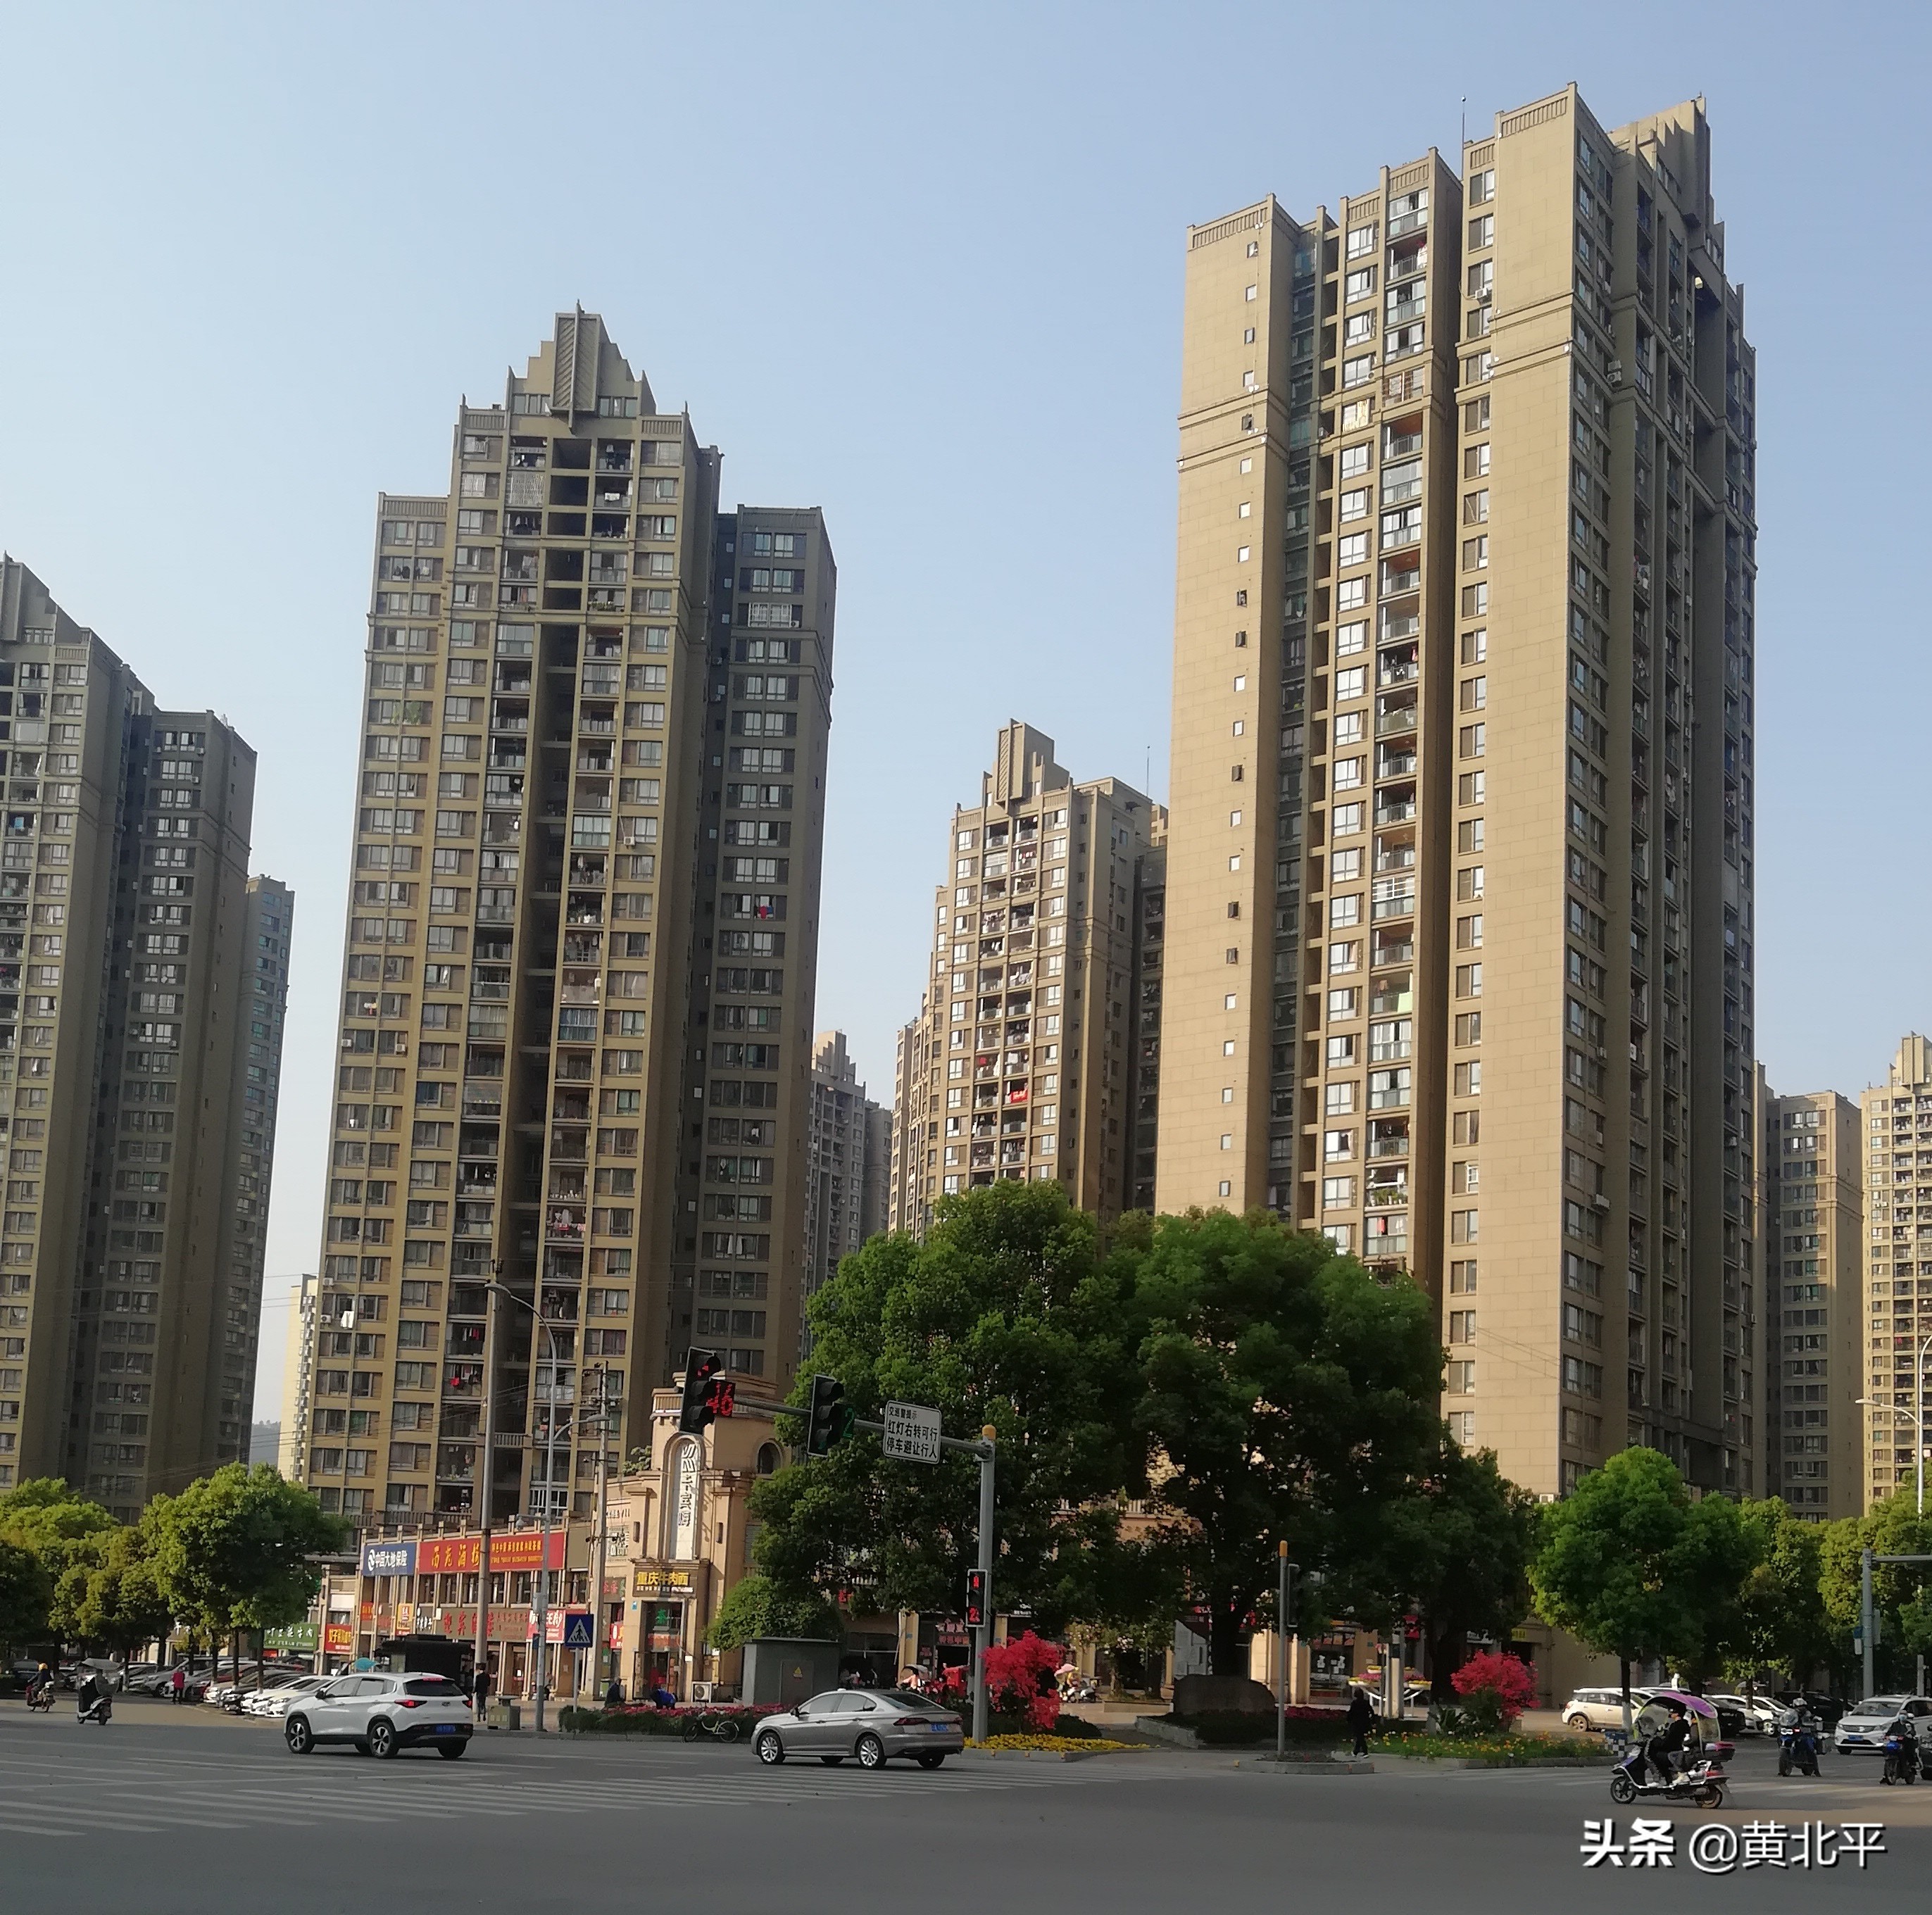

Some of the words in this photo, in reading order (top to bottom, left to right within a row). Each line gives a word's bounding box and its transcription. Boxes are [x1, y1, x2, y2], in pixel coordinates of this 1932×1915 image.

[705, 1381, 733, 1416] 46
[888, 1419, 938, 1441] 红灯右转可行
[886, 1436, 936, 1458] 停车避让行人
[375, 1550, 408, 1568] 中国大地保险
[636, 1571, 689, 1586] 重庆牛肉面
